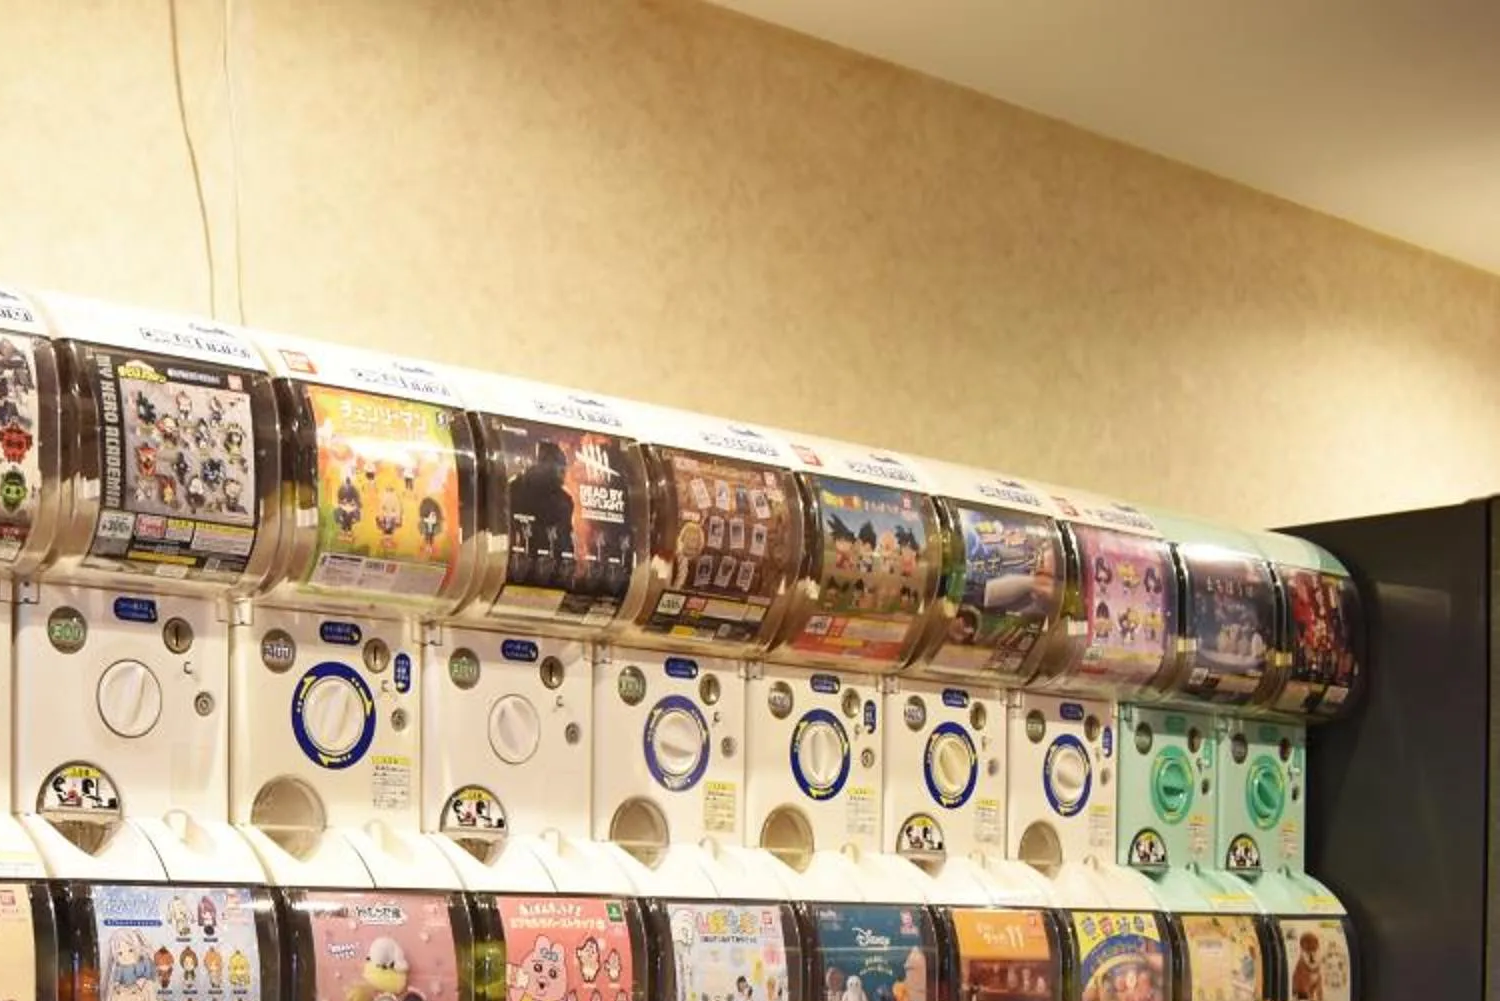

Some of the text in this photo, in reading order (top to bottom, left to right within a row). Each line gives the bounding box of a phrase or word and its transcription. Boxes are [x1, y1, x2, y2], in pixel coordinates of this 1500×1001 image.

[101, 379, 118, 422] HERO
[105, 424, 122, 509] ACADEMIA
[580, 485, 623, 501] DEAD BY
